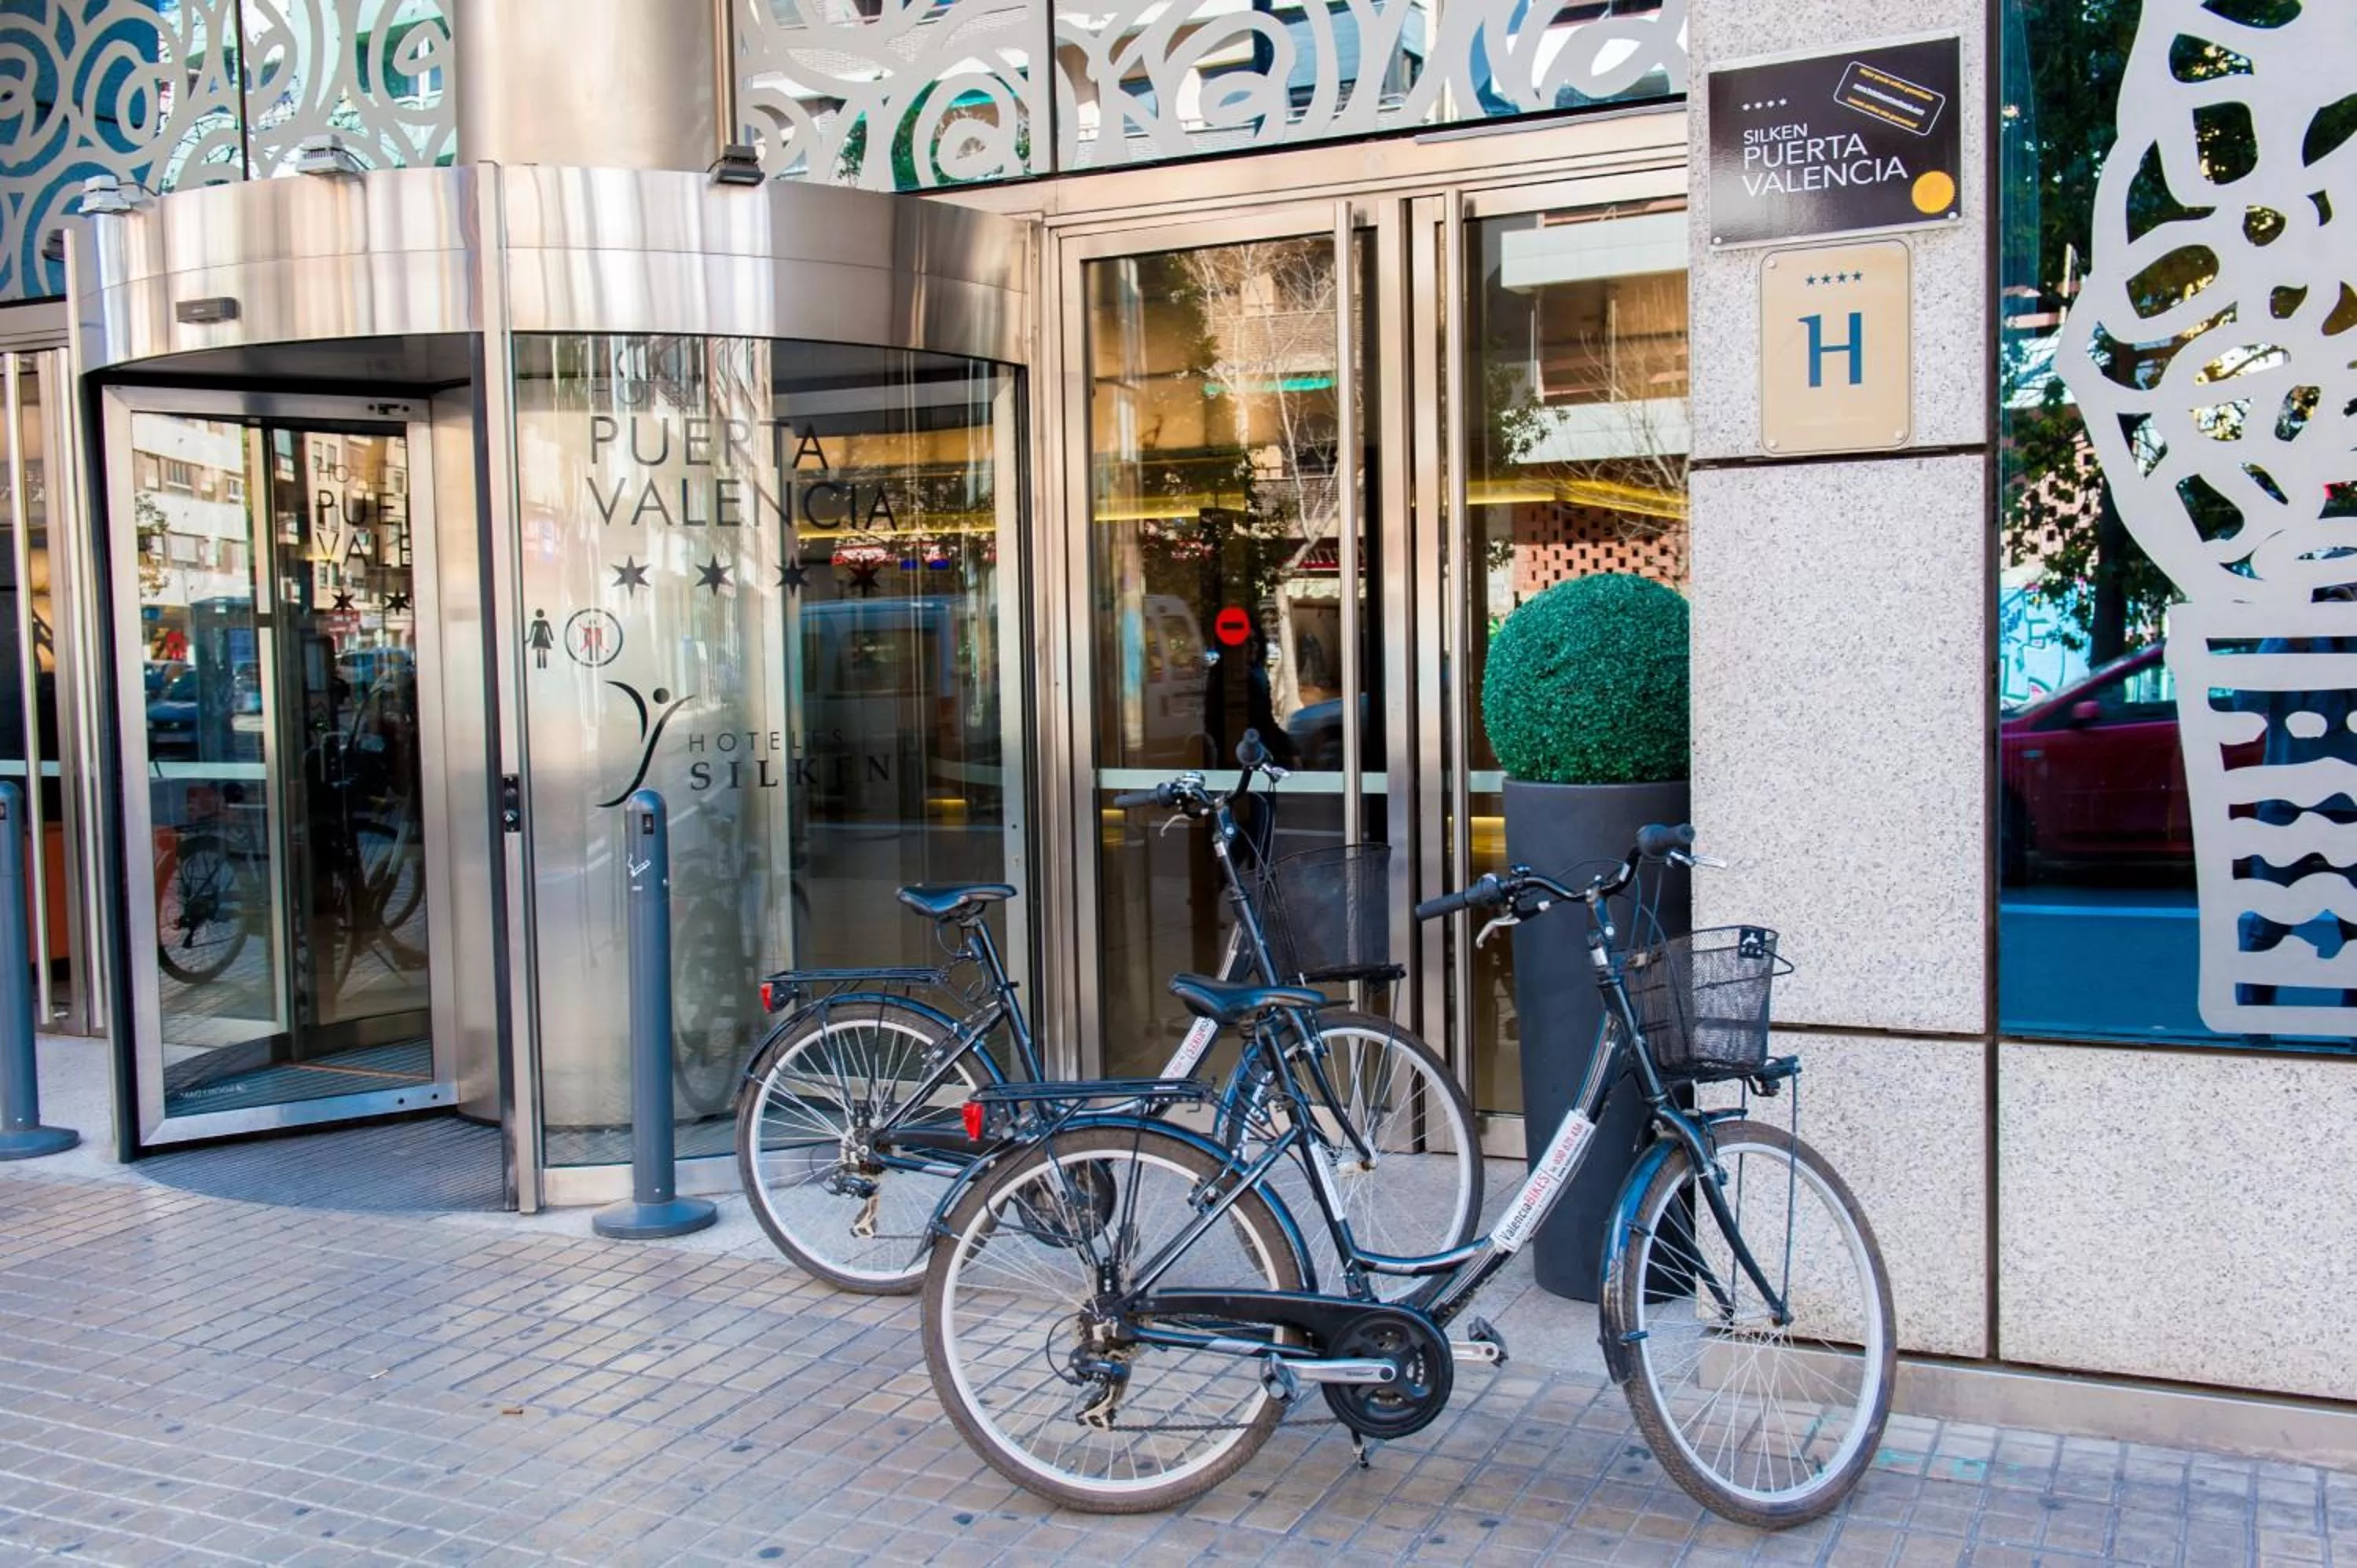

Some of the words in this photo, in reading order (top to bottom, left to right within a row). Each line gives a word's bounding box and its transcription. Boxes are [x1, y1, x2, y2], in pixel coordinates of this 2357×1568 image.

[1743, 123, 1808, 145] SILKEN
[1743, 133, 1869, 170] PUERTA
[1742, 156, 1908, 197] VALENCIA
[1797, 312, 1862, 387] H
[590, 416, 830, 471] PUERTA
[317, 489, 409, 528] PUE
[586, 477, 897, 532] VALENCIA
[688, 727, 844, 752] HOTELES
[690, 753, 890, 790] SILKEN
[1499, 1173, 1550, 1241] ValenciaBIKES
